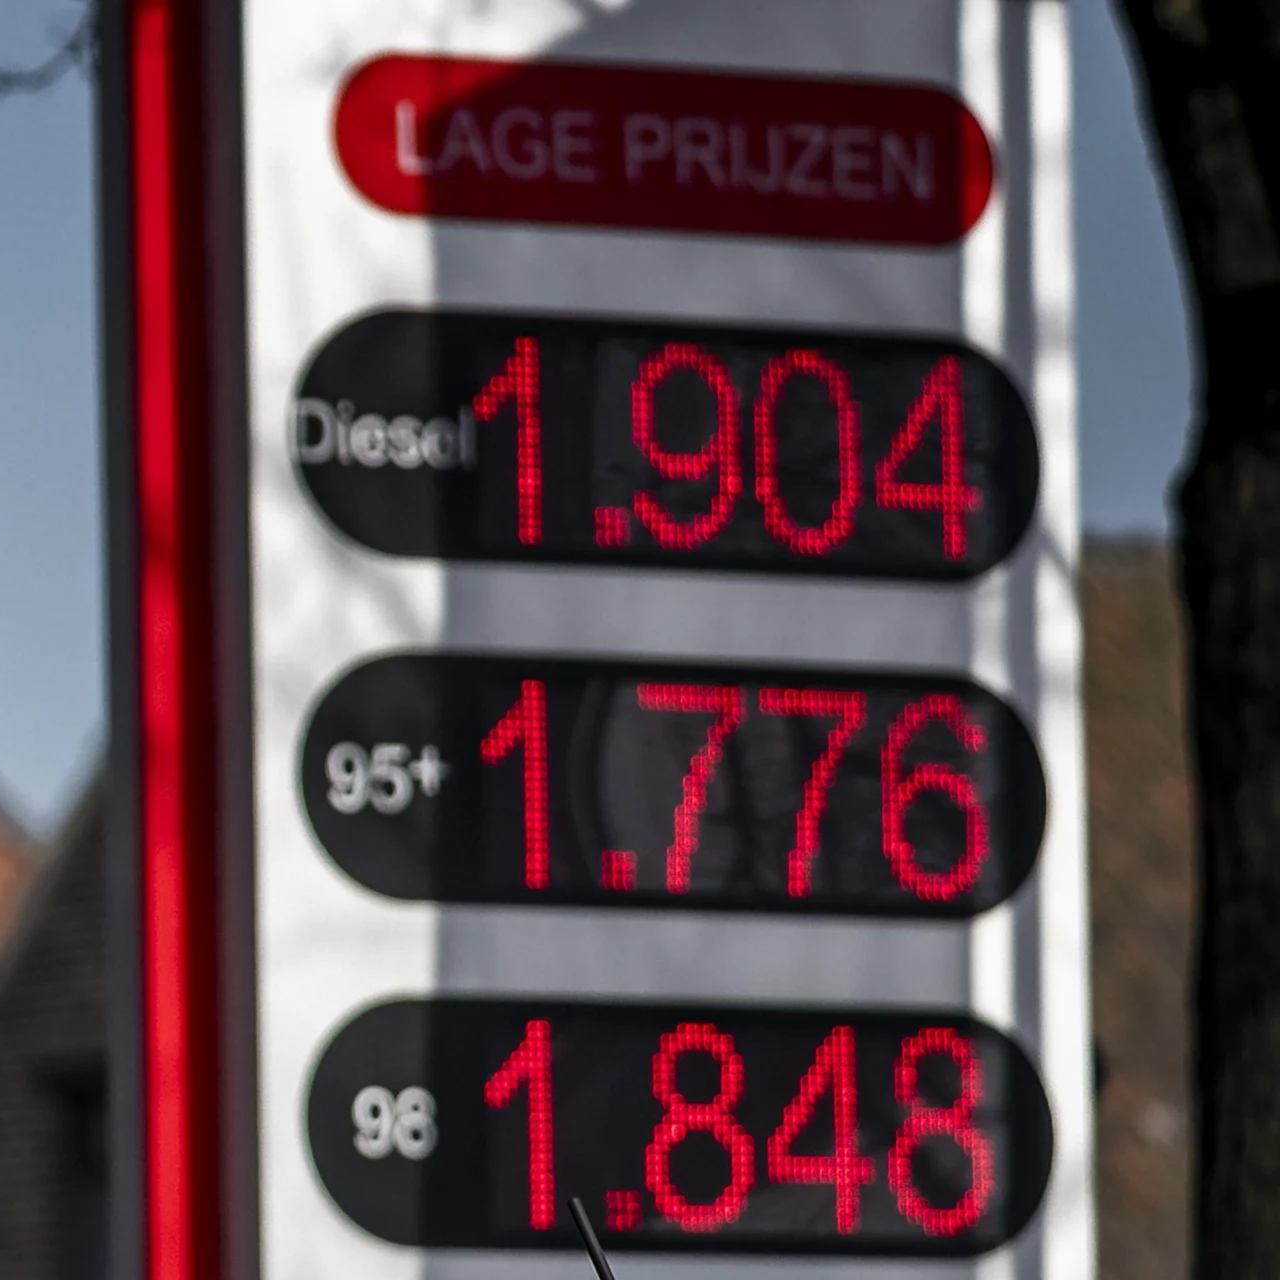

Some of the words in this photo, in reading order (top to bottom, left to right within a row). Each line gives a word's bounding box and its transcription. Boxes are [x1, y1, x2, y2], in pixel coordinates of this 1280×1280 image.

[395, 100, 595, 181] LAGE
[625, 115, 934, 199] PRIJZEN
[293, 399, 478, 470] Diesel
[473, 336, 982, 561] 1.904
[326, 742, 447, 814] 95+
[480, 679, 990, 901] 1.776
[351, 1087, 439, 1160] 98
[484, 1020, 996, 1236] 1.848
